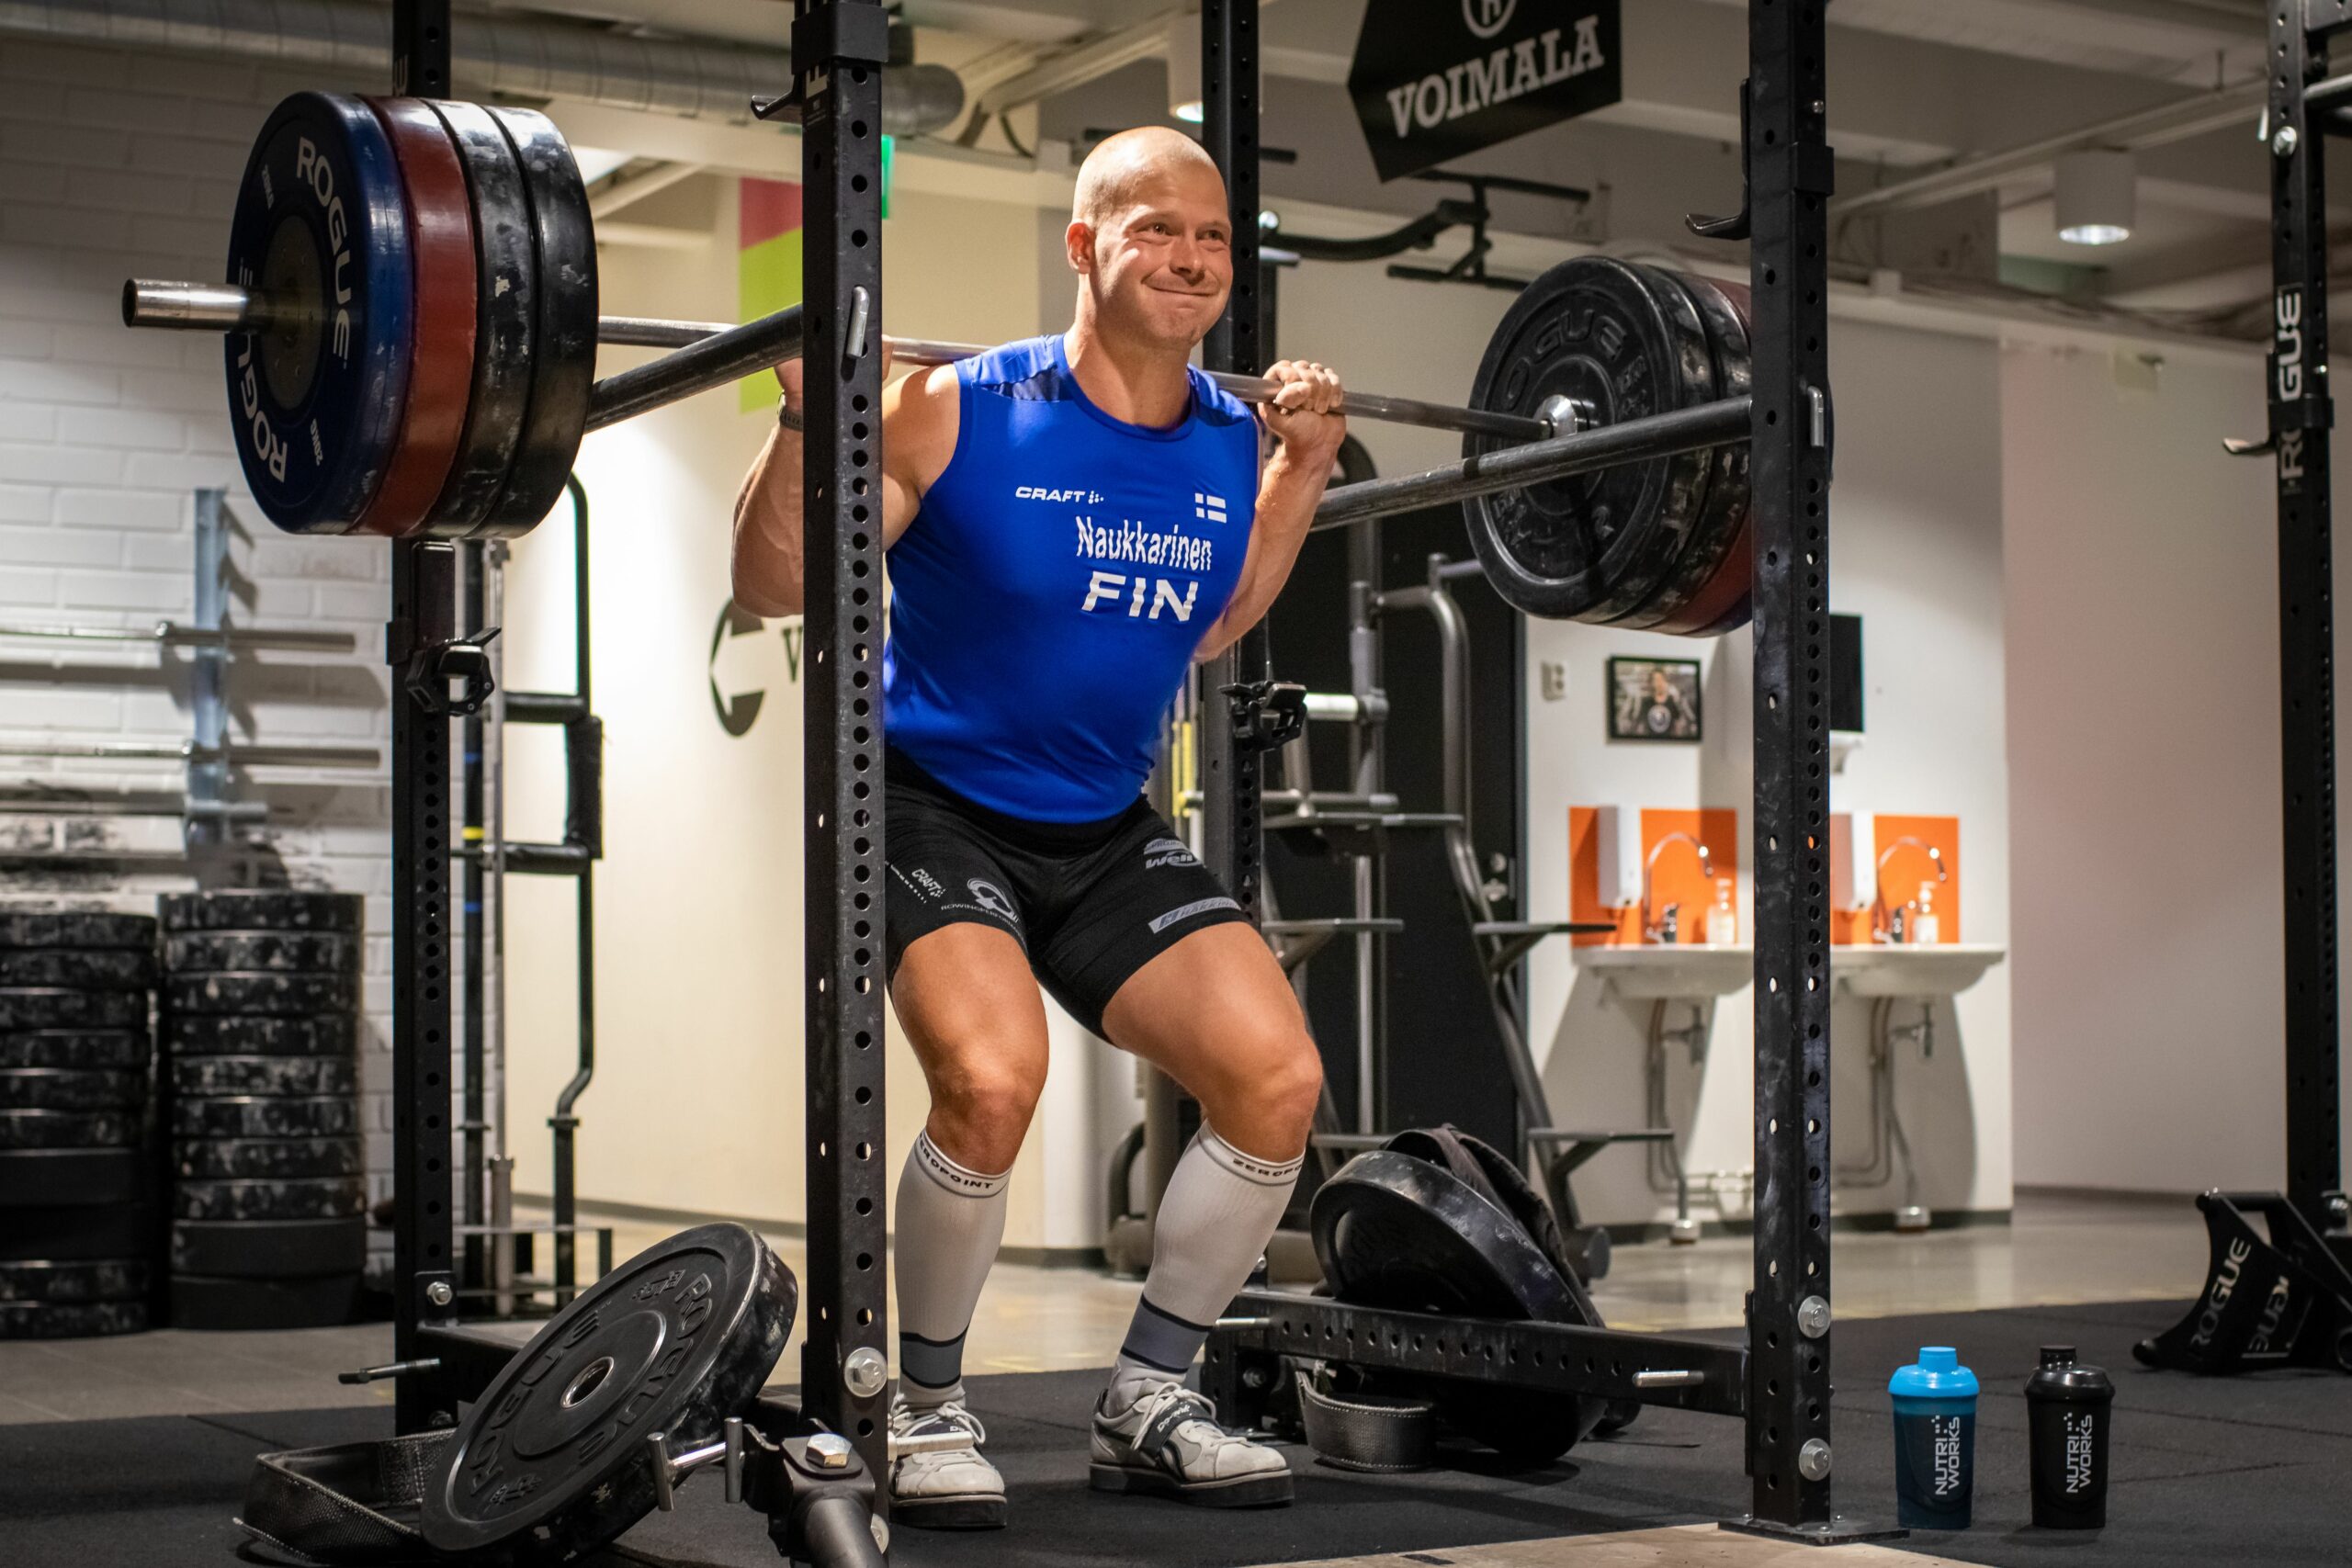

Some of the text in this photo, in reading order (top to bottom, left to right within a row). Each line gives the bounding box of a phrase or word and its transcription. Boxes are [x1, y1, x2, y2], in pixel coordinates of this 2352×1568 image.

[1386, 15, 1605, 138] VOIMALA
[297, 137, 352, 358] ROGUE
[1505, 308, 1628, 412] OGUE
[1015, 486, 1085, 503] CRAFT
[1075, 515, 1212, 570] Naukkarinen
[1080, 570, 1199, 622] FIN
[911, 868, 942, 892] CRAFT
[919, 1133, 993, 1190] EROPOINT
[2190, 1236, 2251, 1360] ROGUE
[1935, 1438, 1948, 1495] NUTRI
[1948, 1416, 1960, 1490] WORKS
[2066, 1436, 2079, 1493] NUTRI
[2079, 1415, 2092, 1488] WORKS
